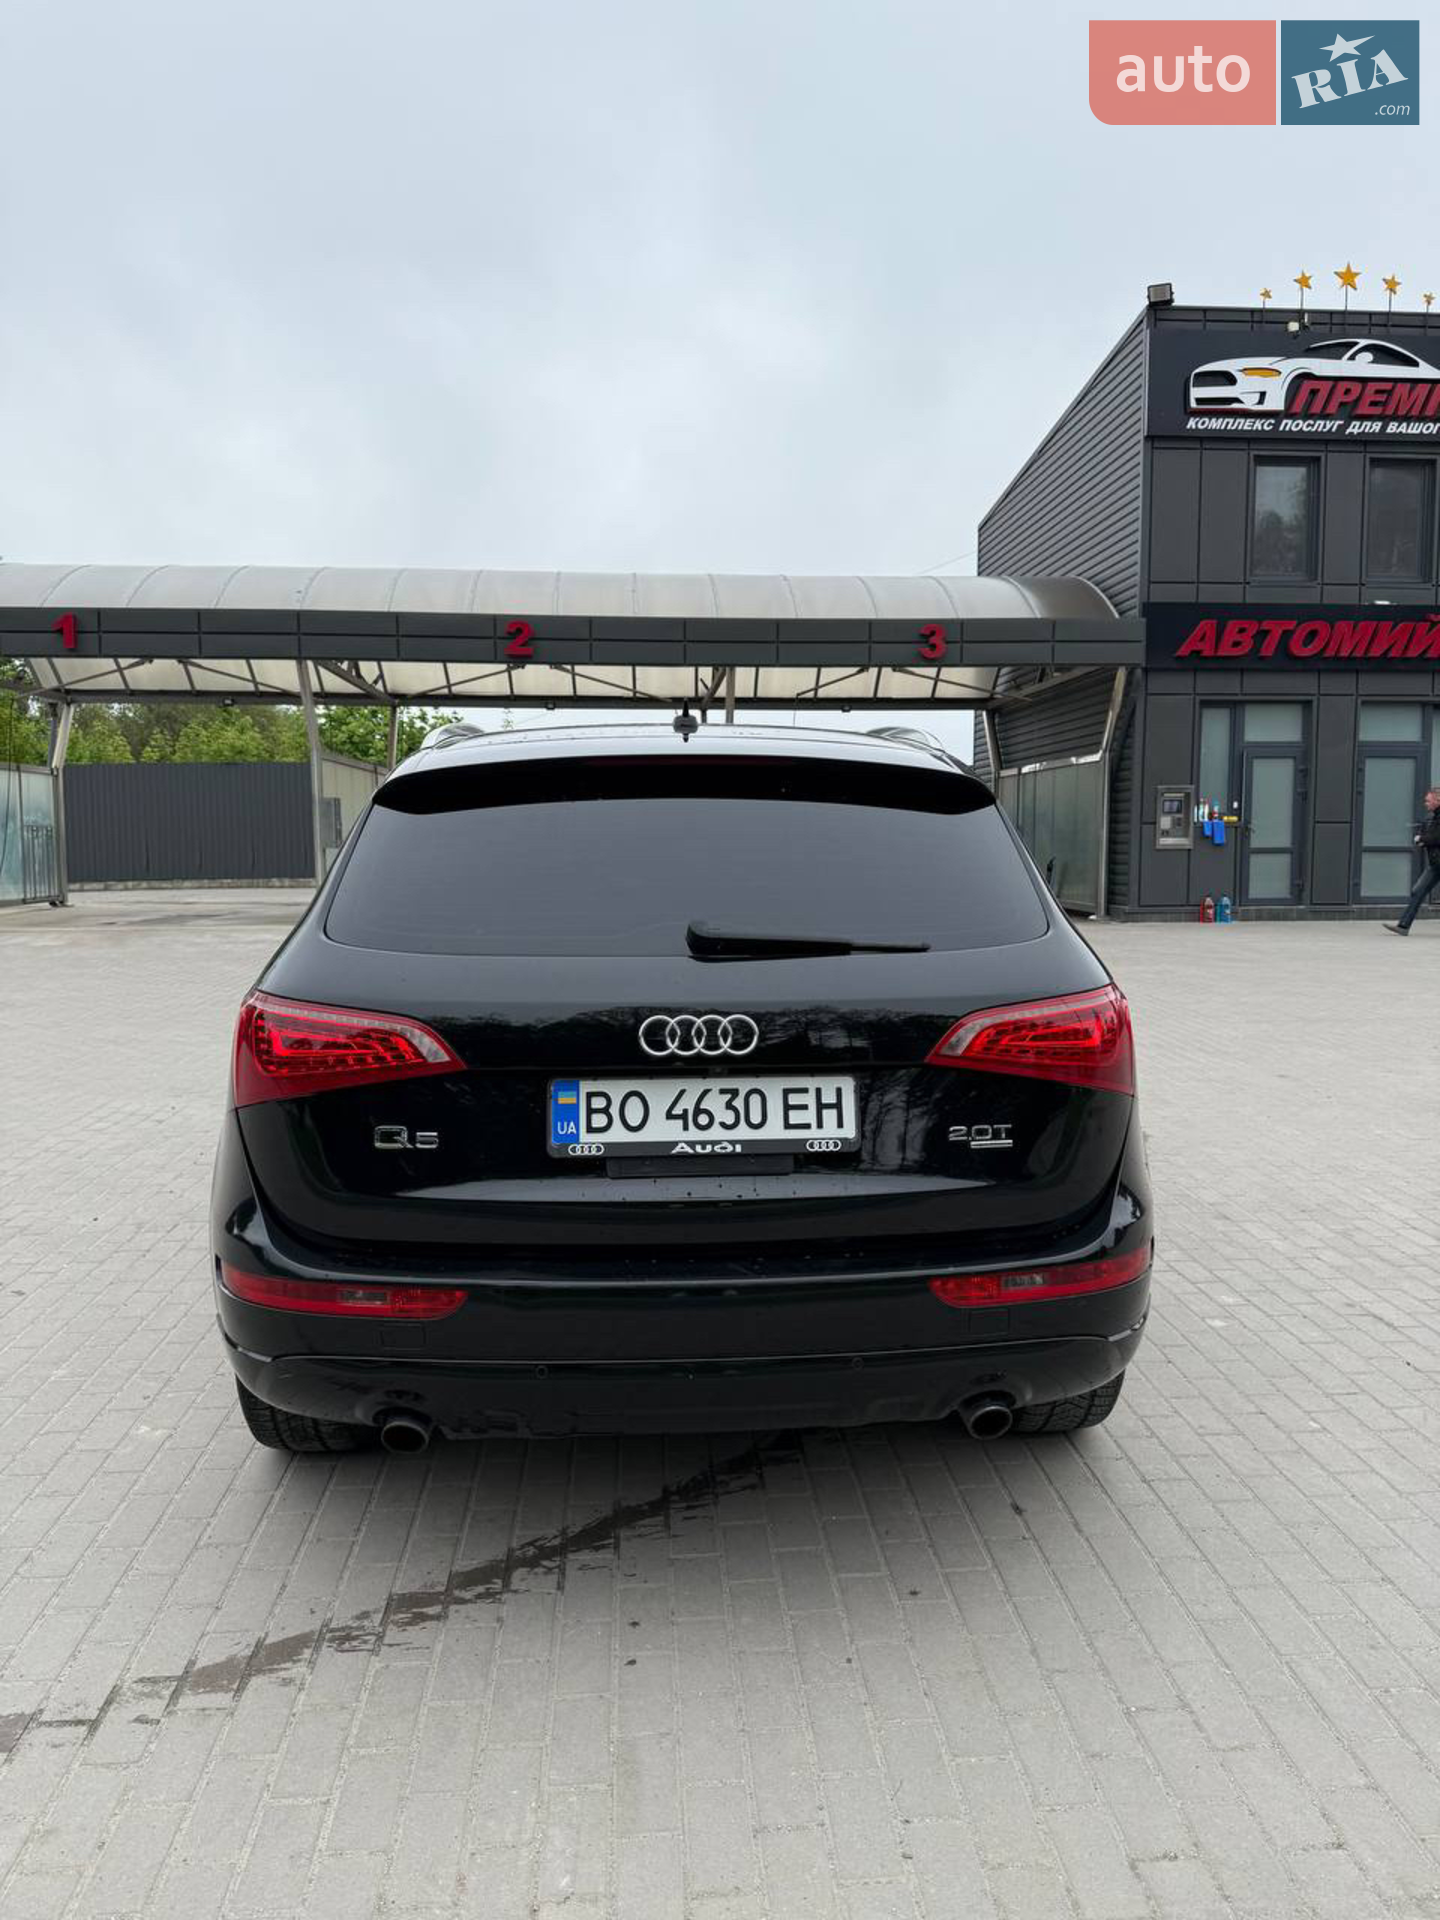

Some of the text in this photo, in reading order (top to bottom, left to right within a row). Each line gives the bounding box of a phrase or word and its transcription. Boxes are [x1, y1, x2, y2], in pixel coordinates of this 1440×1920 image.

[1186, 417, 1276, 431] КОМПЛЕКС
[1279, 419, 1344, 433] ПОСЛУГ
[1345, 420, 1383, 435] ДЛЯ
[51, 612, 78, 650] 1
[504, 619, 536, 658] 2
[918, 623, 948, 660] 3
[557, 1121, 577, 1135] UA
[585, 1086, 845, 1134] BO 4630 EH
[374, 1125, 439, 1149] Q5
